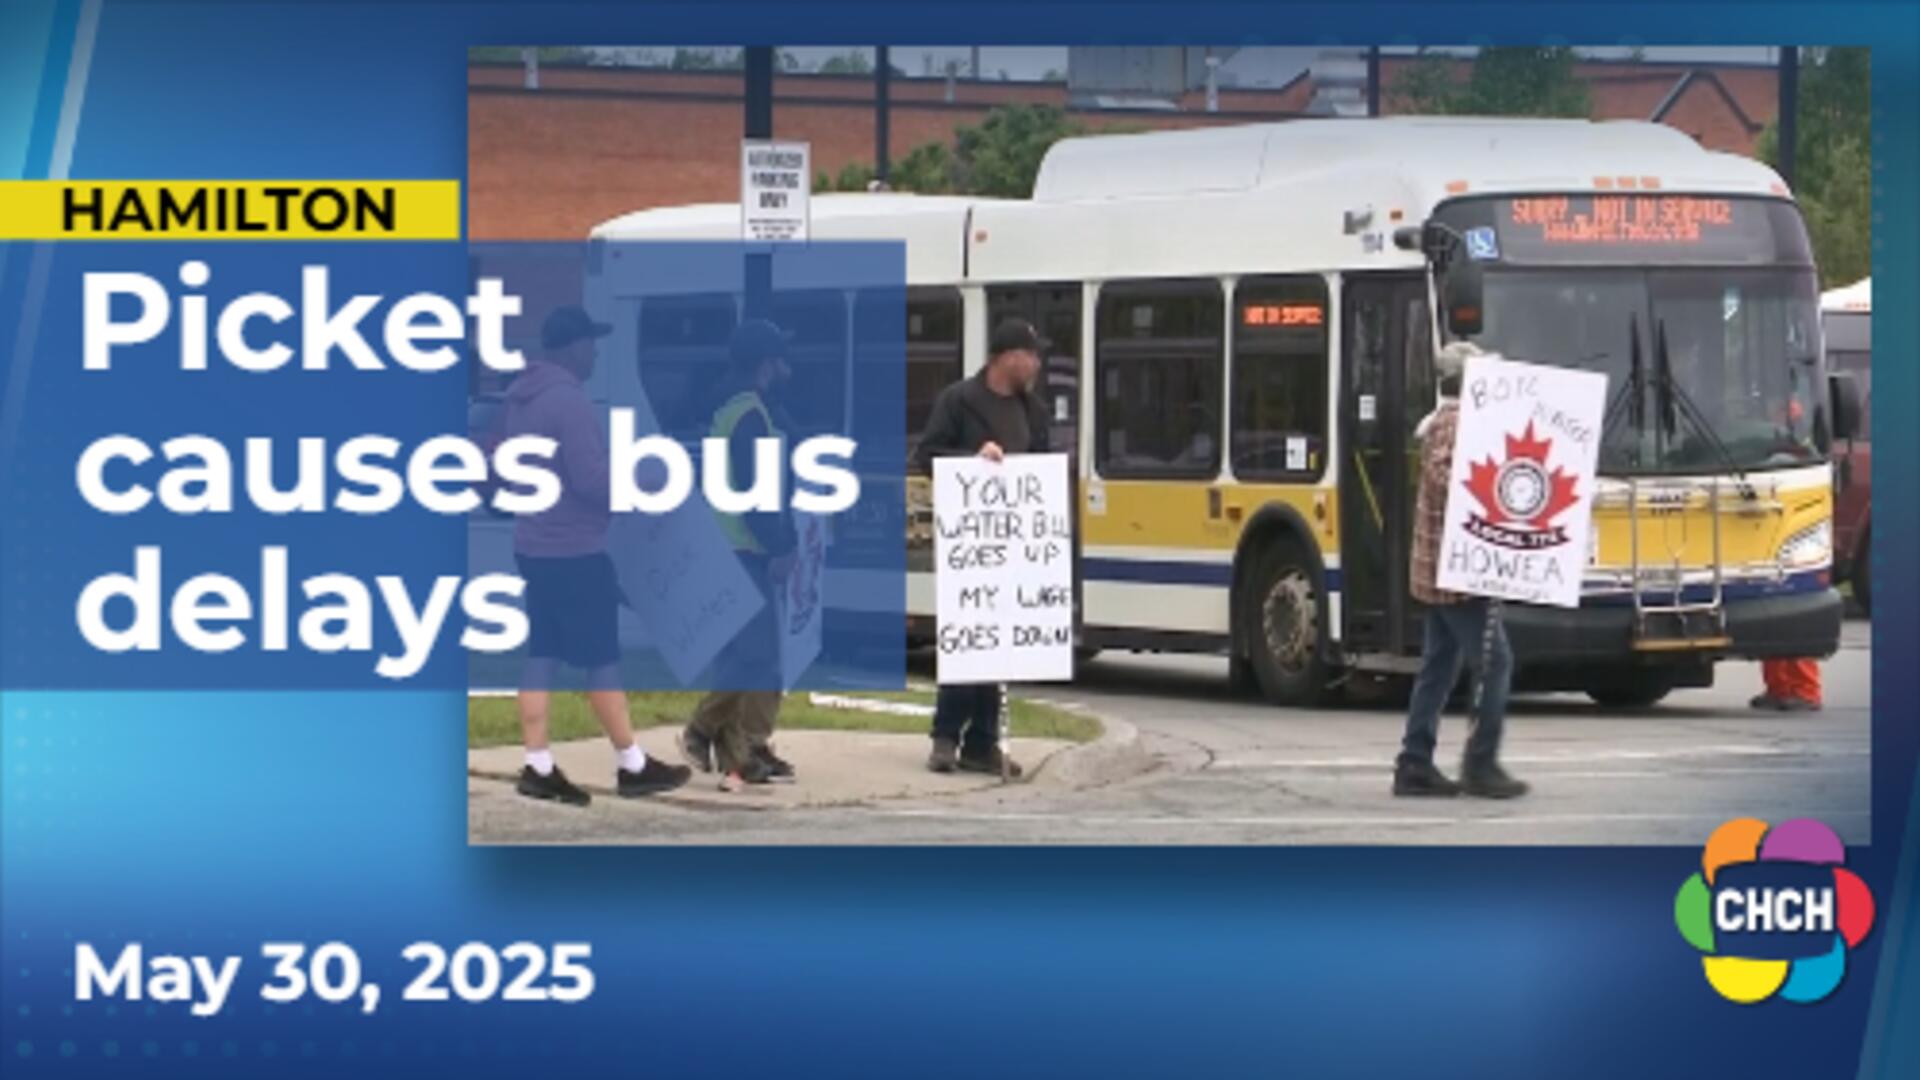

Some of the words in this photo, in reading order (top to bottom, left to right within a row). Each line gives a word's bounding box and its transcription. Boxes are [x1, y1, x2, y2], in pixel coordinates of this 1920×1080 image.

[1593, 196, 1627, 222] NOT
[1634, 196, 1656, 222] IN
[1661, 197, 1731, 224] SERVICE
[955, 470, 1045, 508] YOUR
[936, 511, 1023, 540] WATER
[947, 545, 1007, 571] GOES
[1023, 544, 1061, 566] UP
[1448, 541, 1564, 586] HOWEA
[959, 585, 999, 609] MY
[1017, 584, 1071, 609] WAGE
[940, 624, 1000, 655] GOES
[1012, 625, 1070, 647] DOWN
